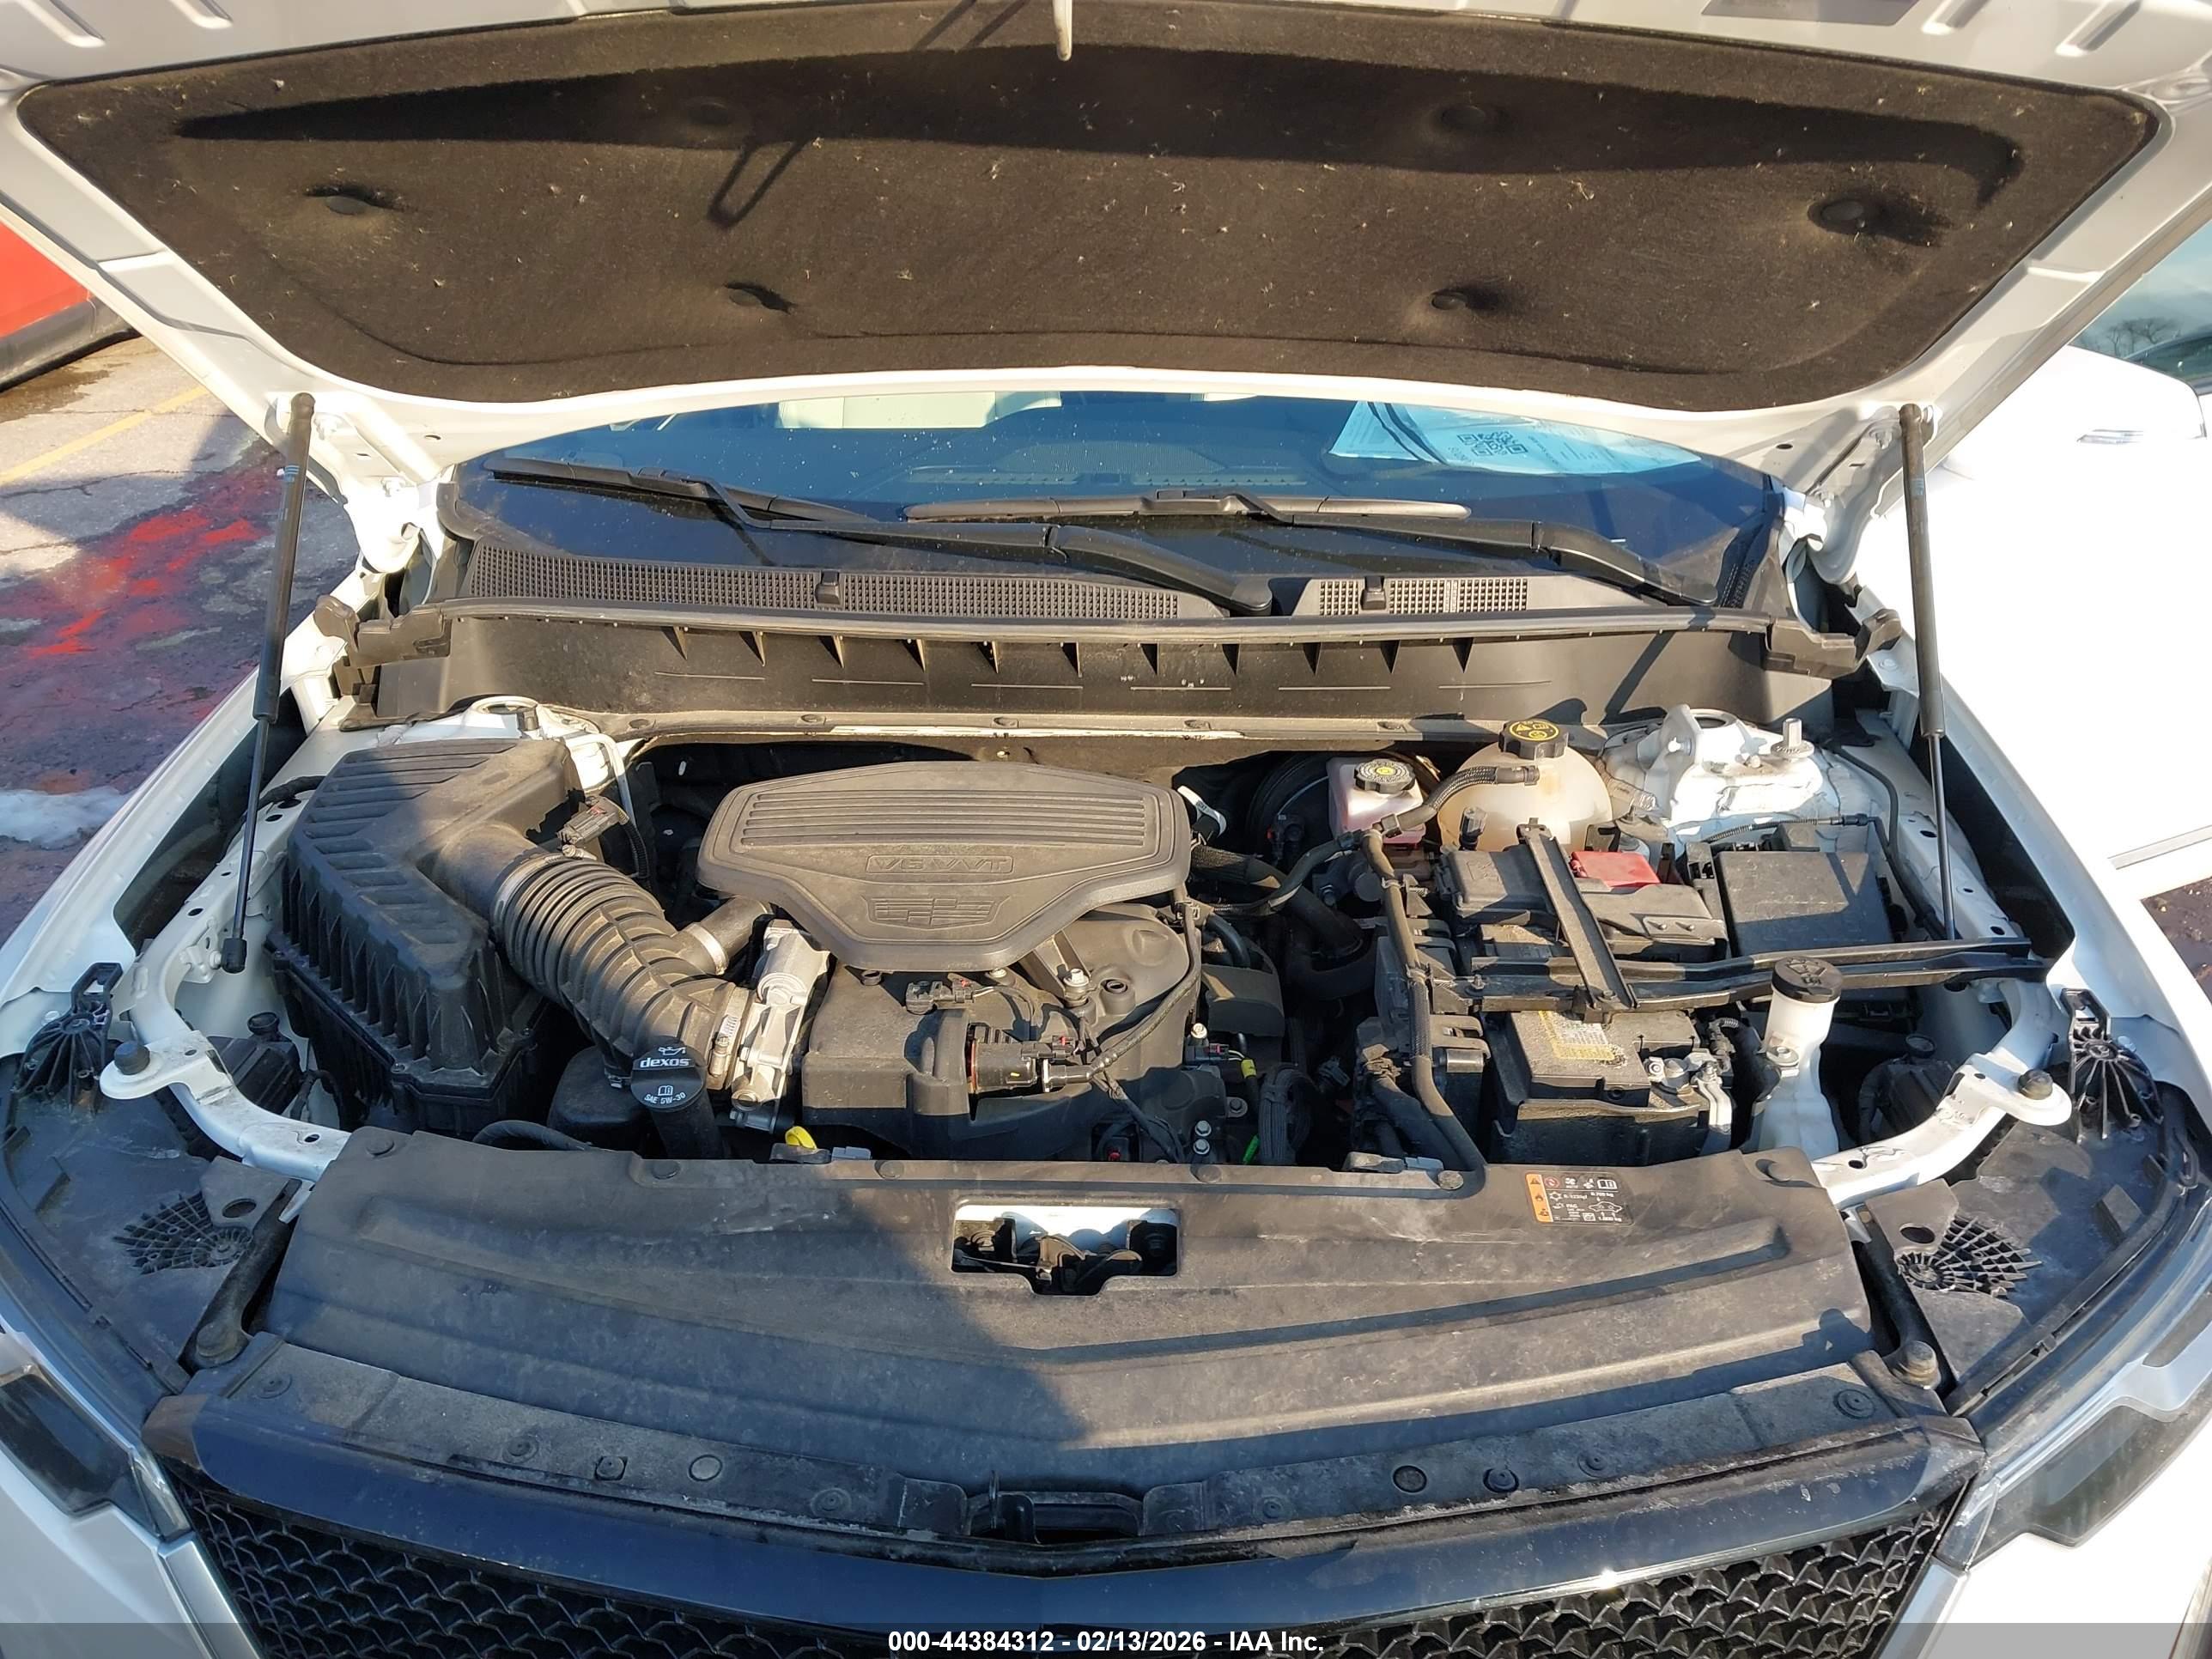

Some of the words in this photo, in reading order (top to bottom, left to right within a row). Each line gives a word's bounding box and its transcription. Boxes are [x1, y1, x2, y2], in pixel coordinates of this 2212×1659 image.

[873, 857, 925, 871] V6
[933, 858, 1007, 872] VVT
[640, 1057, 691, 1068] dexos
[644, 1093, 659, 1104] SAE
[659, 1091, 686, 1104] 5W-30
